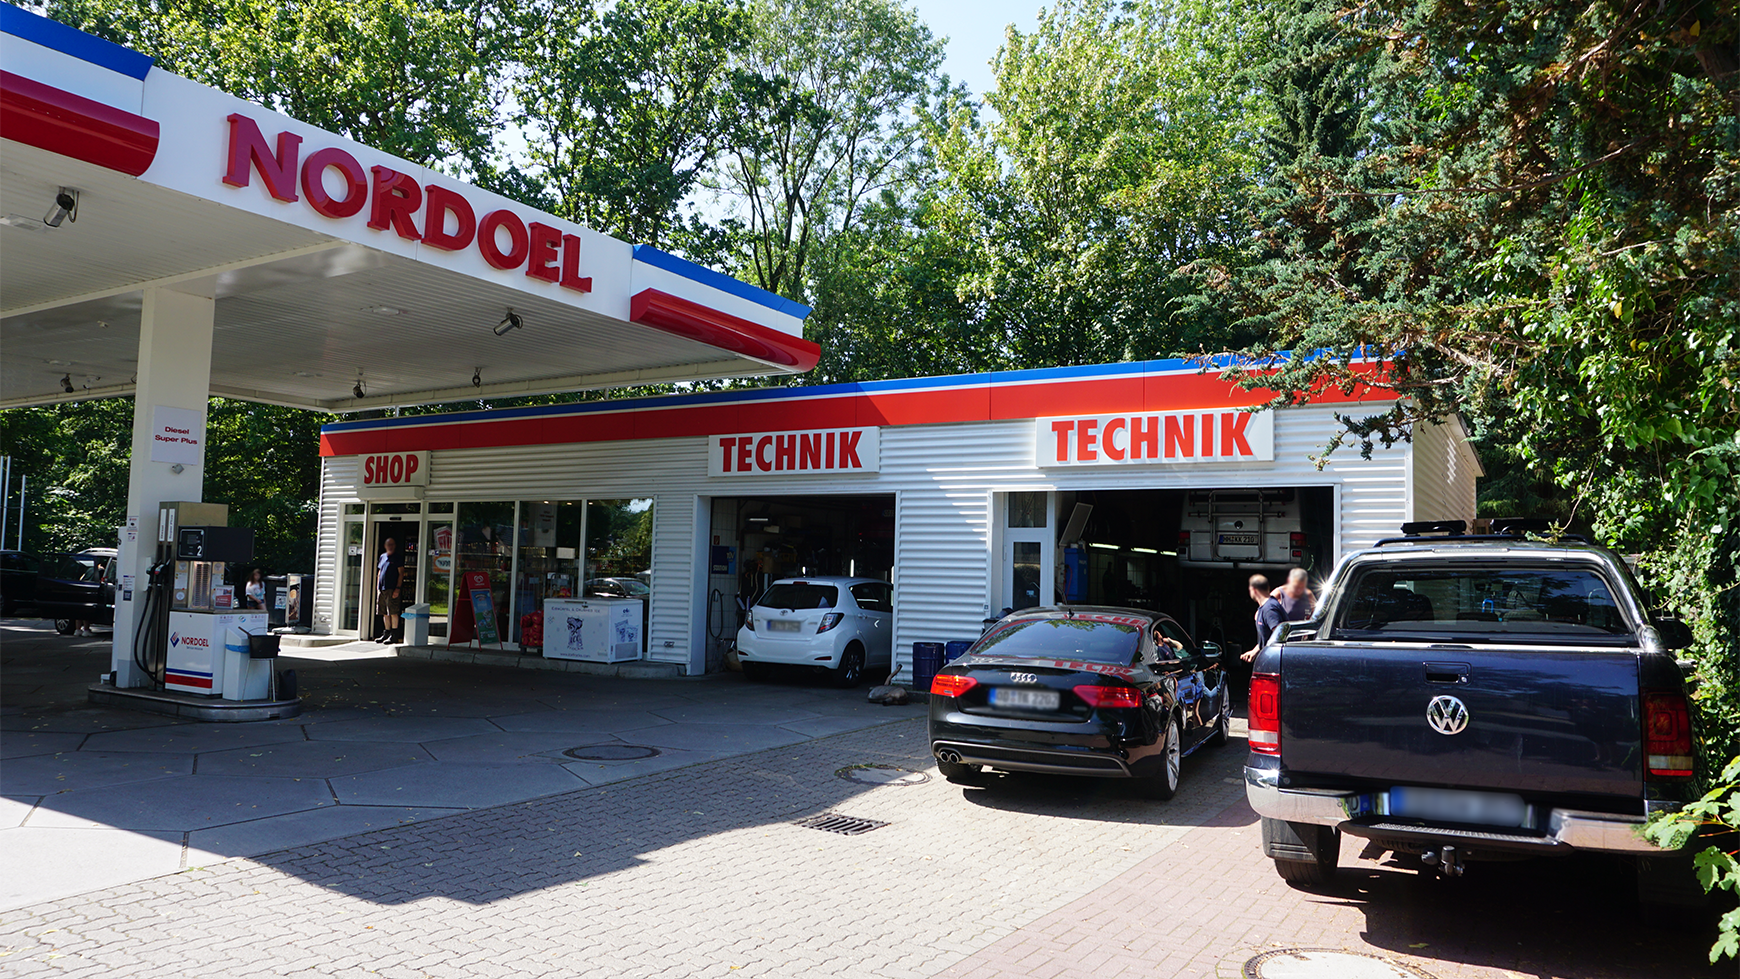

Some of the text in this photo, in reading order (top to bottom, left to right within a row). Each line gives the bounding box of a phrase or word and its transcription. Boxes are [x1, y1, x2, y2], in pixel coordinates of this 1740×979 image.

[222, 112, 593, 294] NORDOEL
[154, 434, 198, 445] Super Plus
[164, 426, 190, 434] Diesel
[1051, 412, 1254, 462] TECHNIK
[719, 430, 863, 473] TECHNIK
[363, 454, 419, 485] SHOP
[197, 545, 202, 556] 2
[181, 636, 209, 647] NORDOEL
